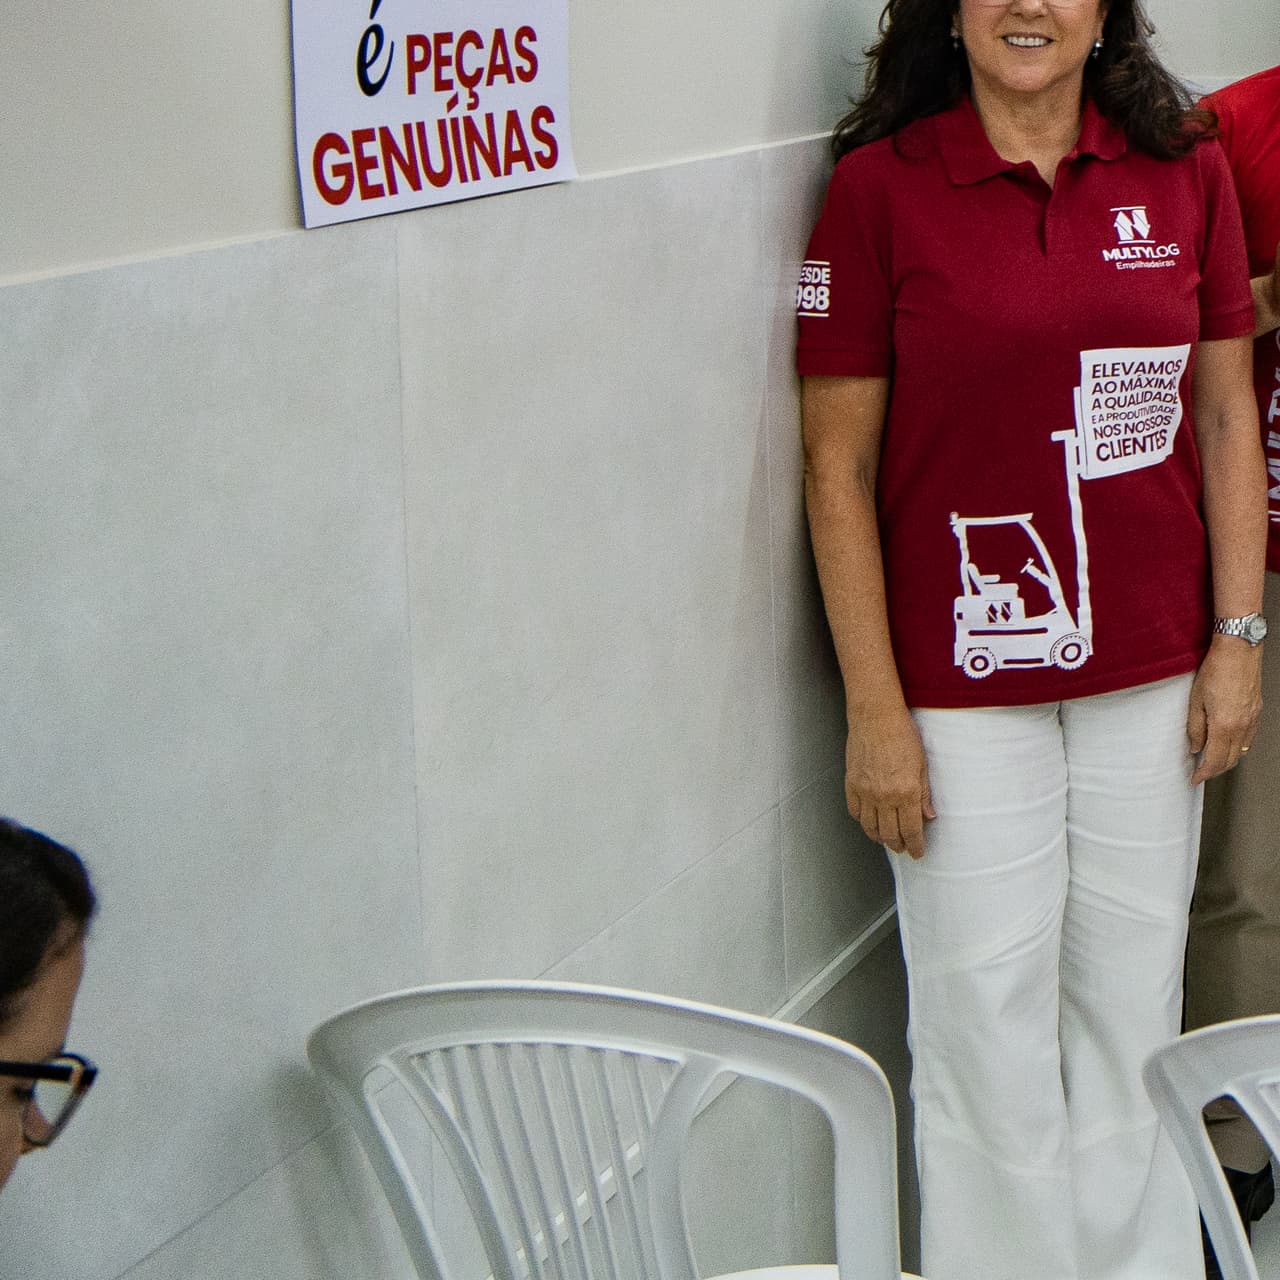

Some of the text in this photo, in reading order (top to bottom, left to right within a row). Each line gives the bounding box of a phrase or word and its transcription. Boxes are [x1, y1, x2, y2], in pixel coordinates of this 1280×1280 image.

[406, 25, 539, 111] PEÇAS
[311, 91, 560, 206] GENUÍNAS
[1102, 243, 1180, 261] MULTYLOG
[1092, 359, 1182, 379] ELEVAMOS
[1092, 381, 1117, 395] AO
[1092, 398, 1101, 411] A
[1092, 405, 1176, 424] E A PRODUTIVIDADE
[1093, 414, 1173, 441] NOS NOSSOS
[1096, 428, 1168, 462] CLIENTES
